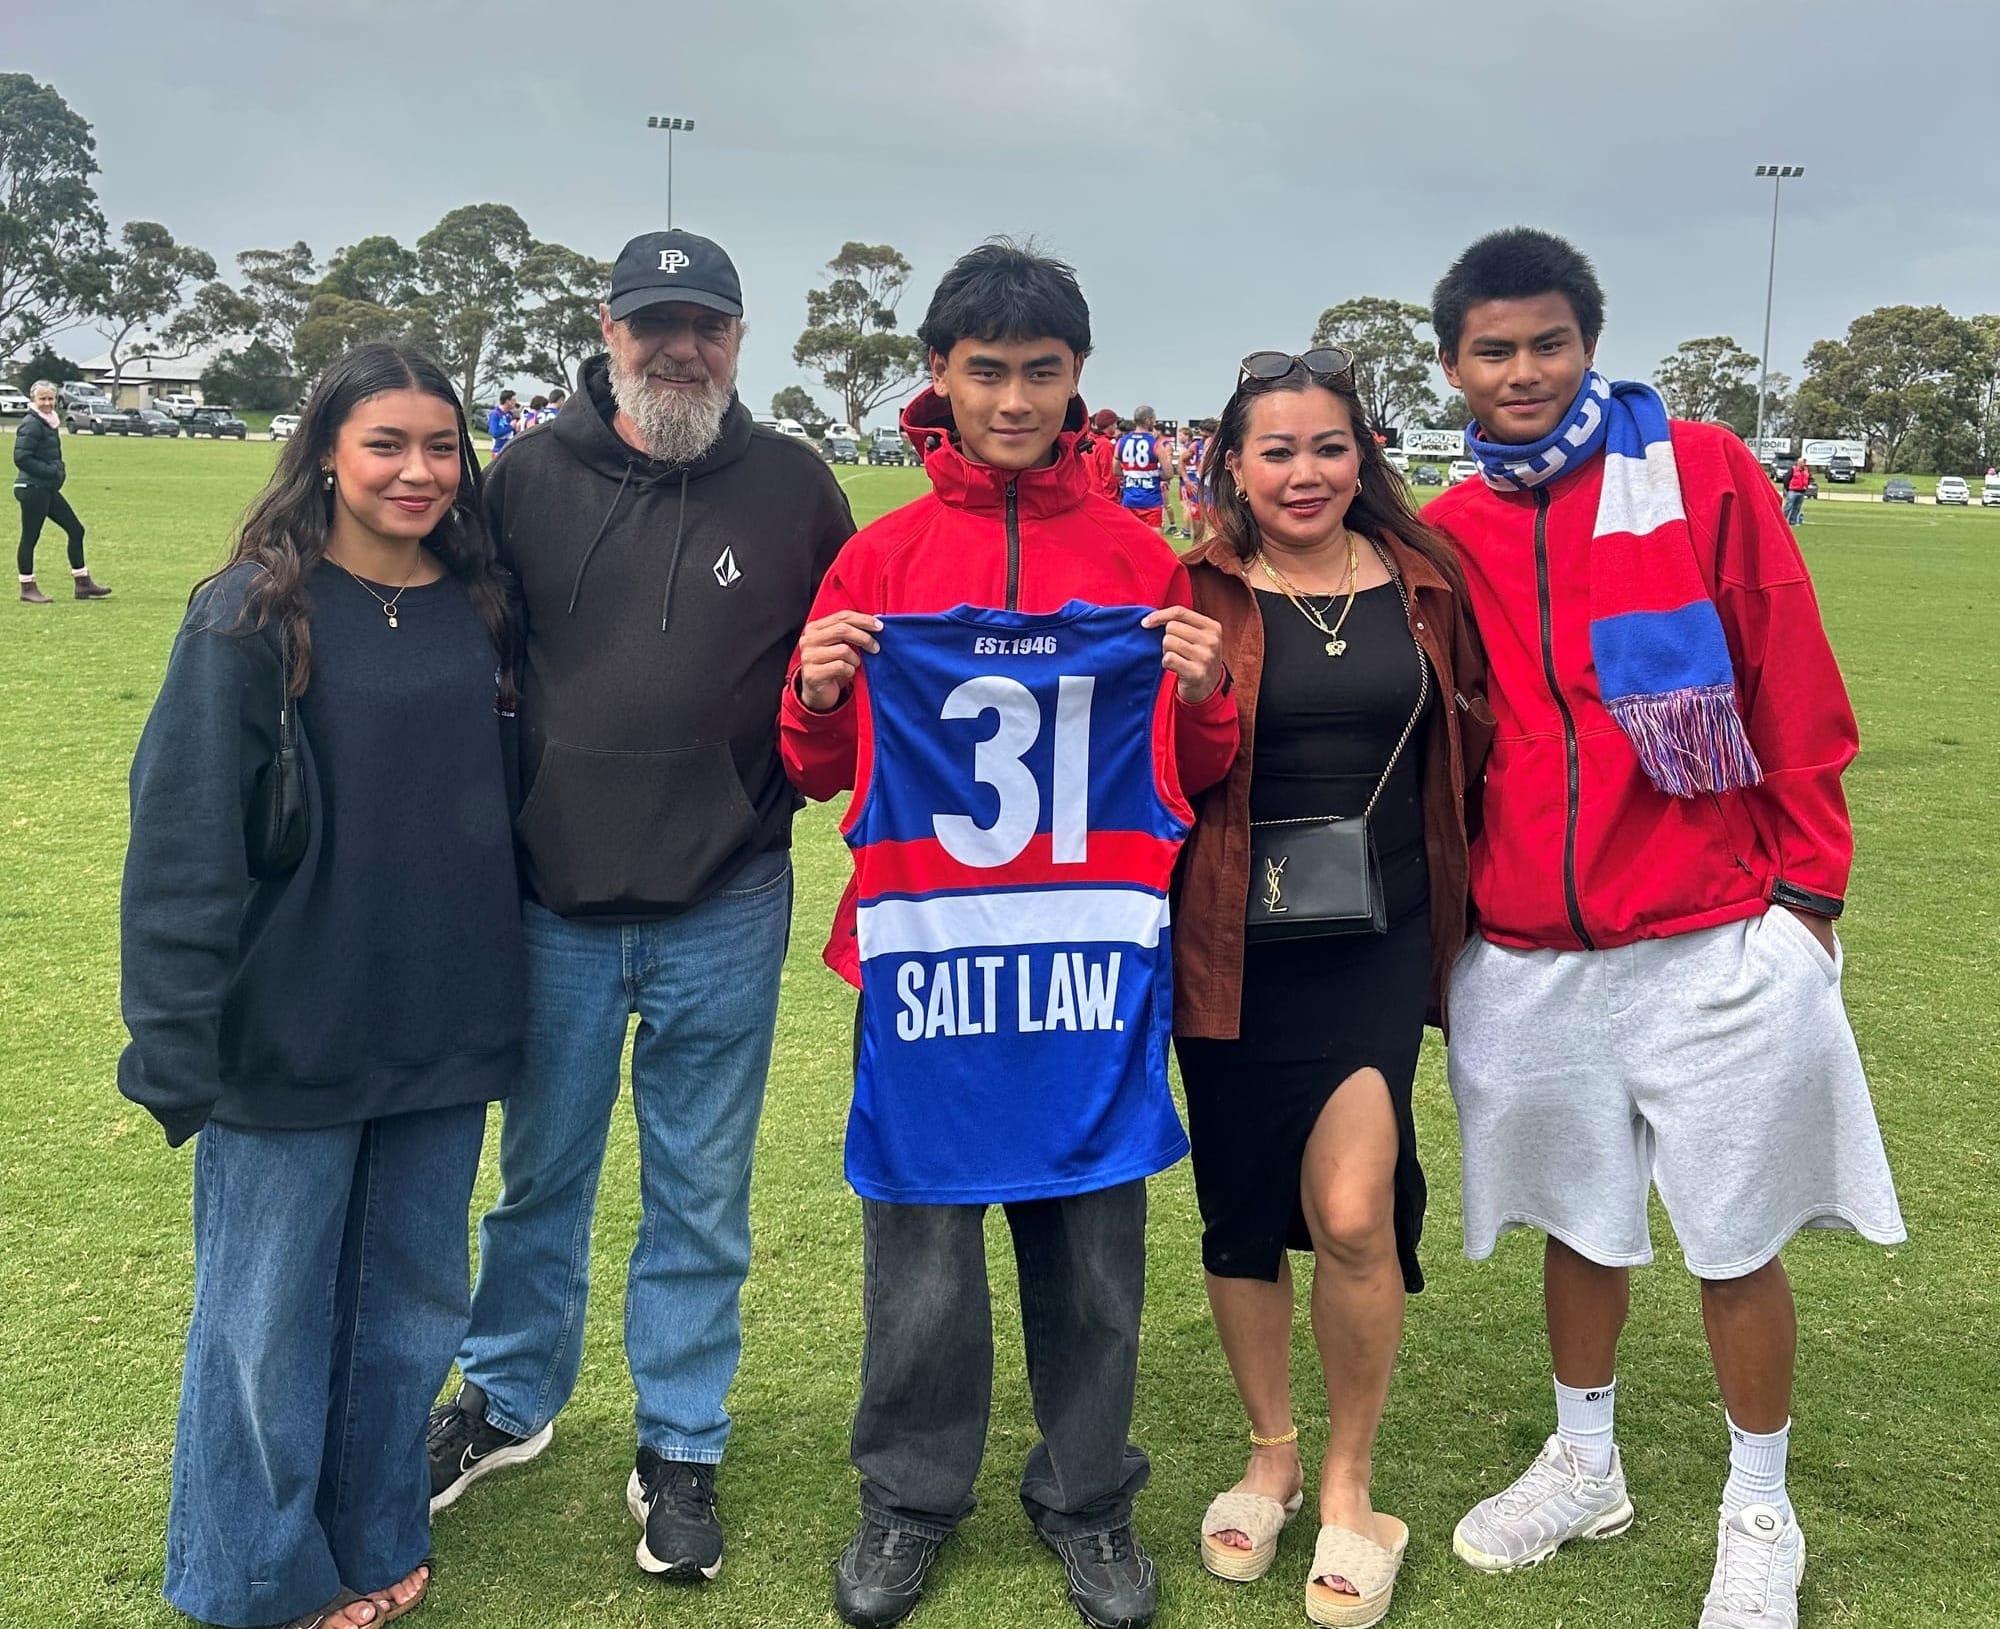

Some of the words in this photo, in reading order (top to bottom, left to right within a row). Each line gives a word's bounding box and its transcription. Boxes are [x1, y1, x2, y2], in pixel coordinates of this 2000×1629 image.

[657, 249, 690, 274] PP
[1121, 438, 1150, 468] 48
[1421, 443, 1449, 451] WORLD
[974, 635, 1057, 655] EST.1946
[931, 675, 1096, 869] 31
[1263, 856, 1289, 913] YSL
[896, 956, 1004, 1042] SALT
[1018, 951, 1124, 1033] LAW.
